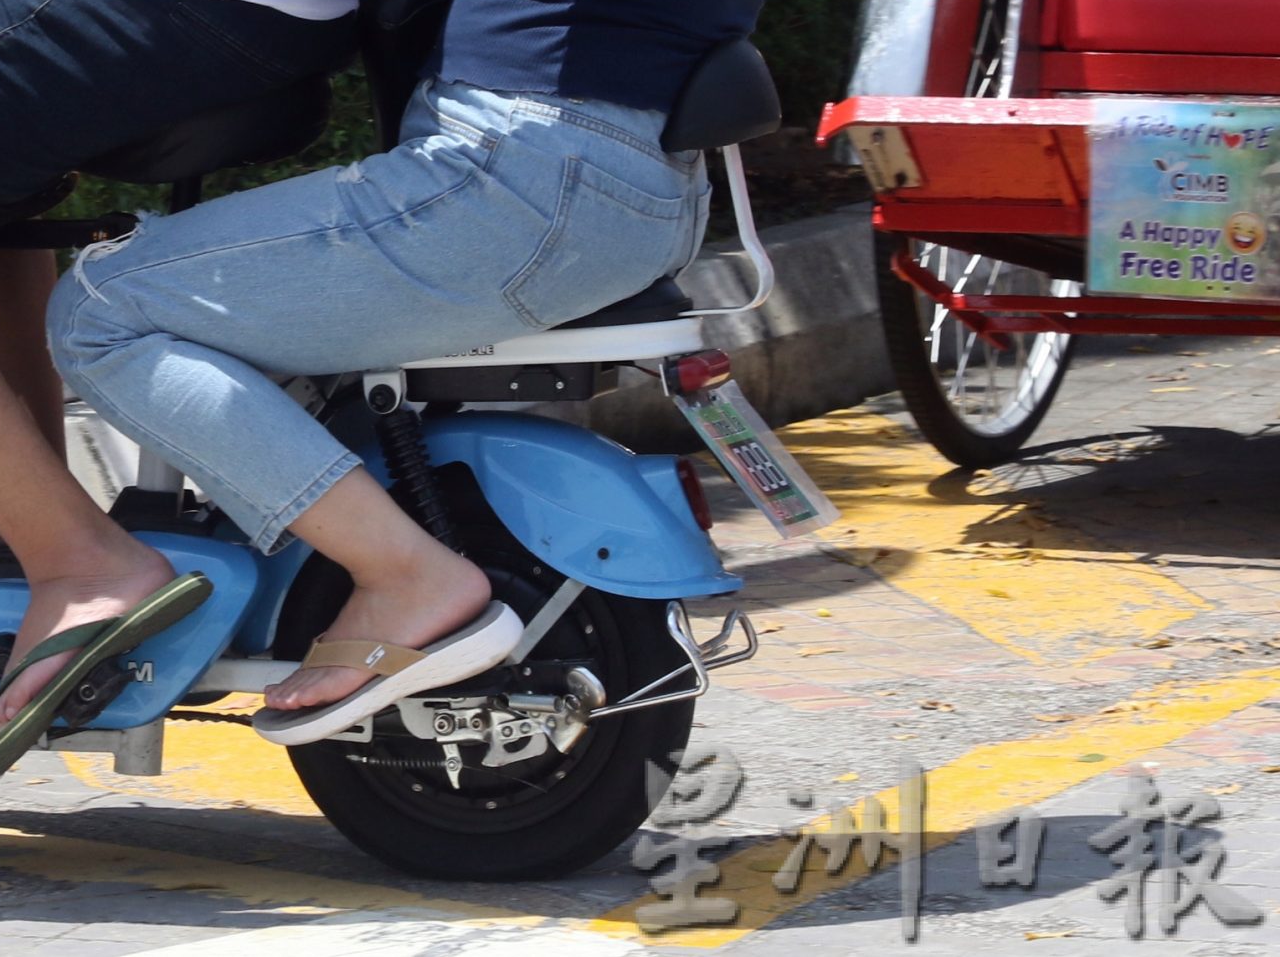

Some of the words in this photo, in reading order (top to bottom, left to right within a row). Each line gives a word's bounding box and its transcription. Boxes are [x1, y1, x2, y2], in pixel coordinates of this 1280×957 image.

[1179, 124, 1206, 146] of
[1171, 173, 1230, 193] CIMB
[1120, 220, 1137, 241] A
[1143, 221, 1222, 250] Happy
[1121, 252, 1183, 279] Free
[1190, 255, 1257, 283] Ride
